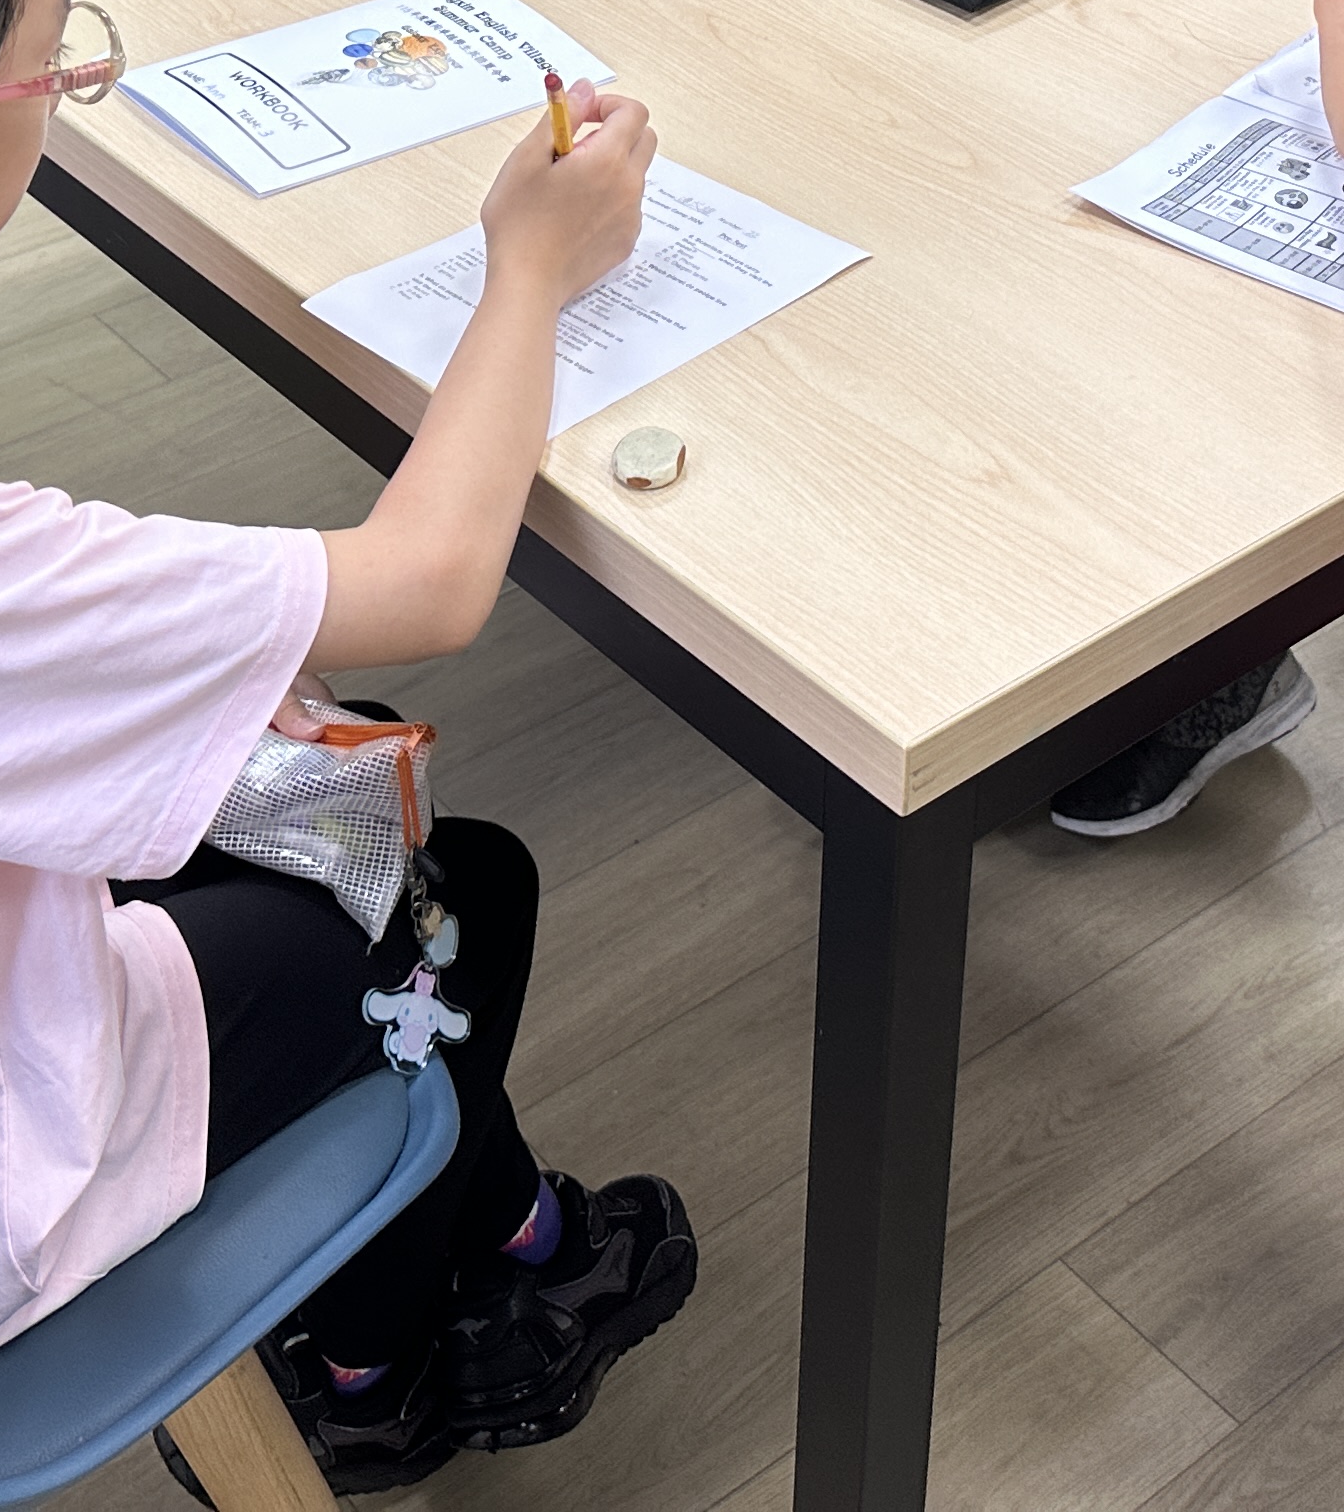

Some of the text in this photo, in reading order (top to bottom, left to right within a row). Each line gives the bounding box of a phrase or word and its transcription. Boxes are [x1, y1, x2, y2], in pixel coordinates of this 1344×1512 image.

[433, 5, 513, 61] Summer Camp
[474, 11, 518, 41] English
[518, 41, 558, 74] Village
[229, 71, 308, 131] WORKBOOK
[1167, 141, 1216, 178] Schedule
